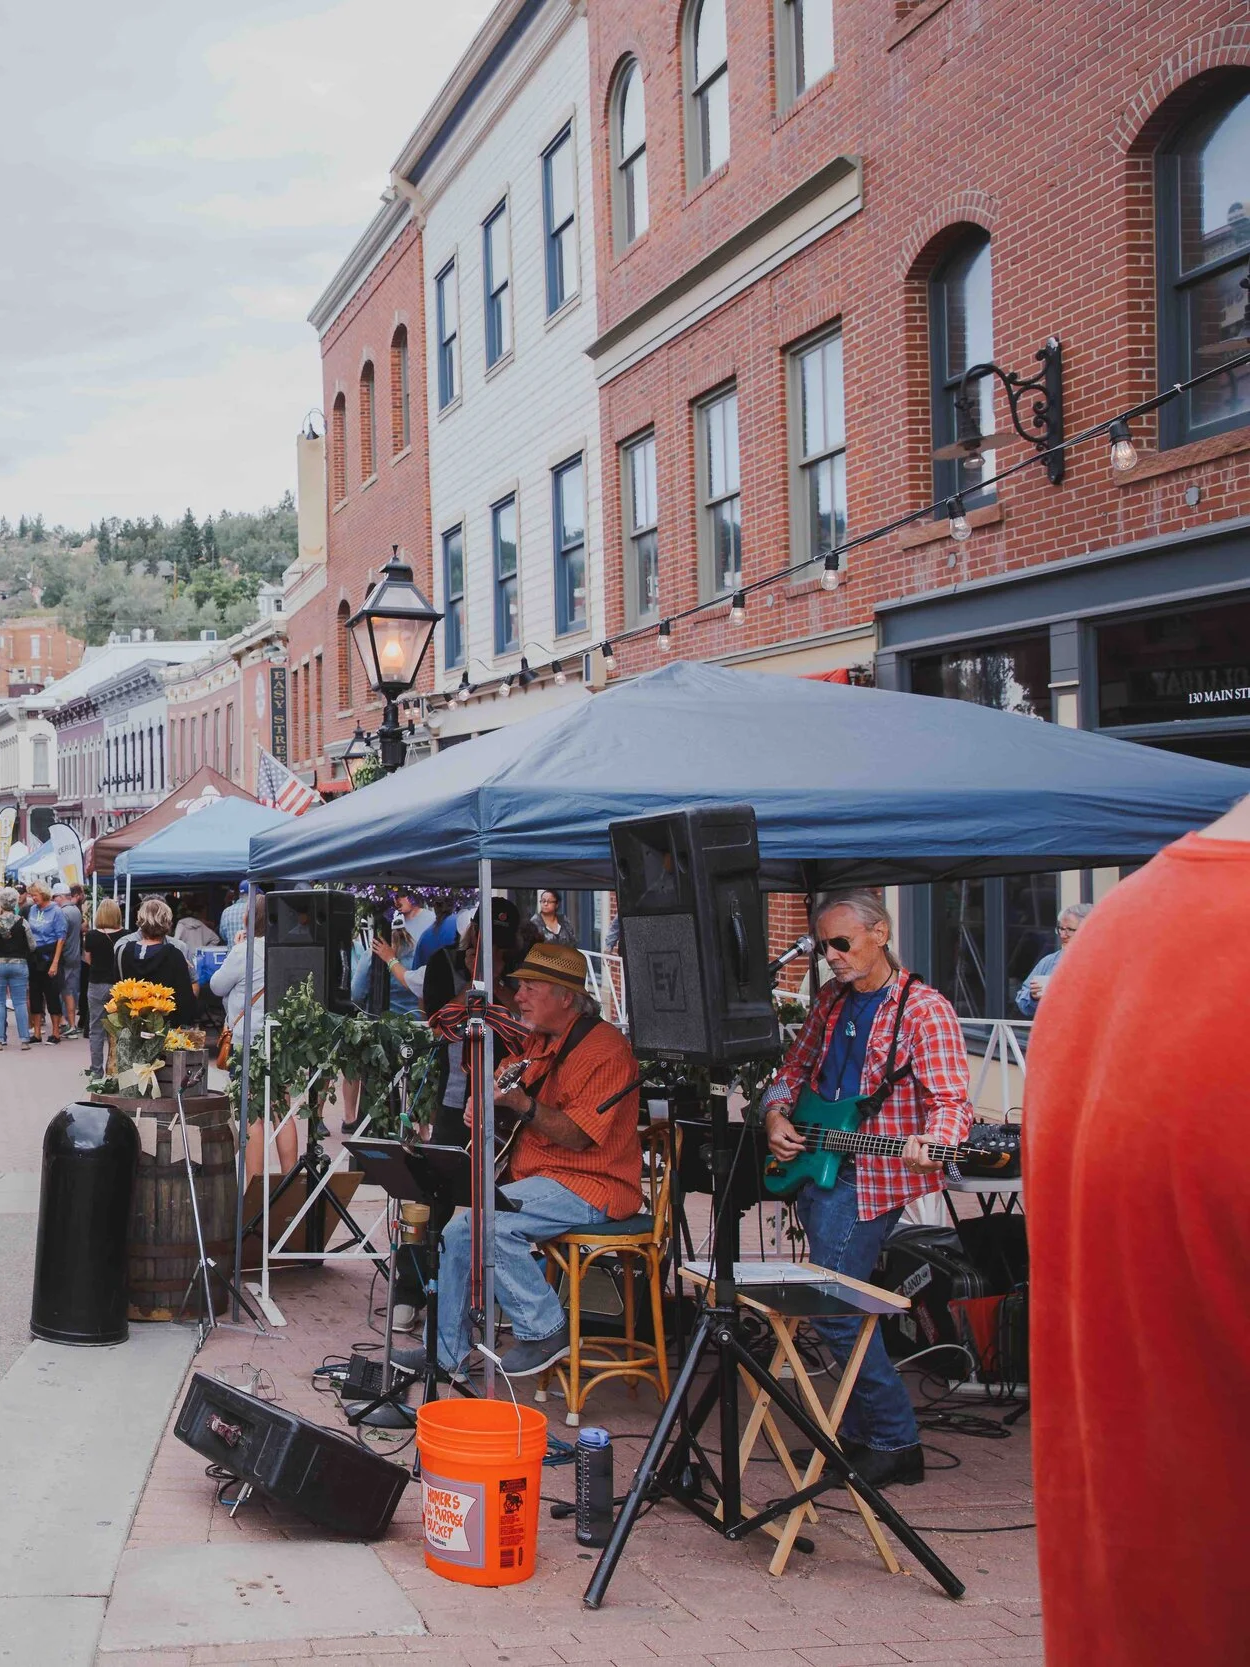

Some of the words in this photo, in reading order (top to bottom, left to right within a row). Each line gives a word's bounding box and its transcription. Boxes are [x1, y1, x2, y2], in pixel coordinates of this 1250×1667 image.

[273, 671, 285, 709] EASY
[1189, 692, 1203, 704] 130
[1204, 689, 1233, 702] MAIN
[274, 715, 286, 764] STREE
[427, 1519, 453, 1539] BUCKET
